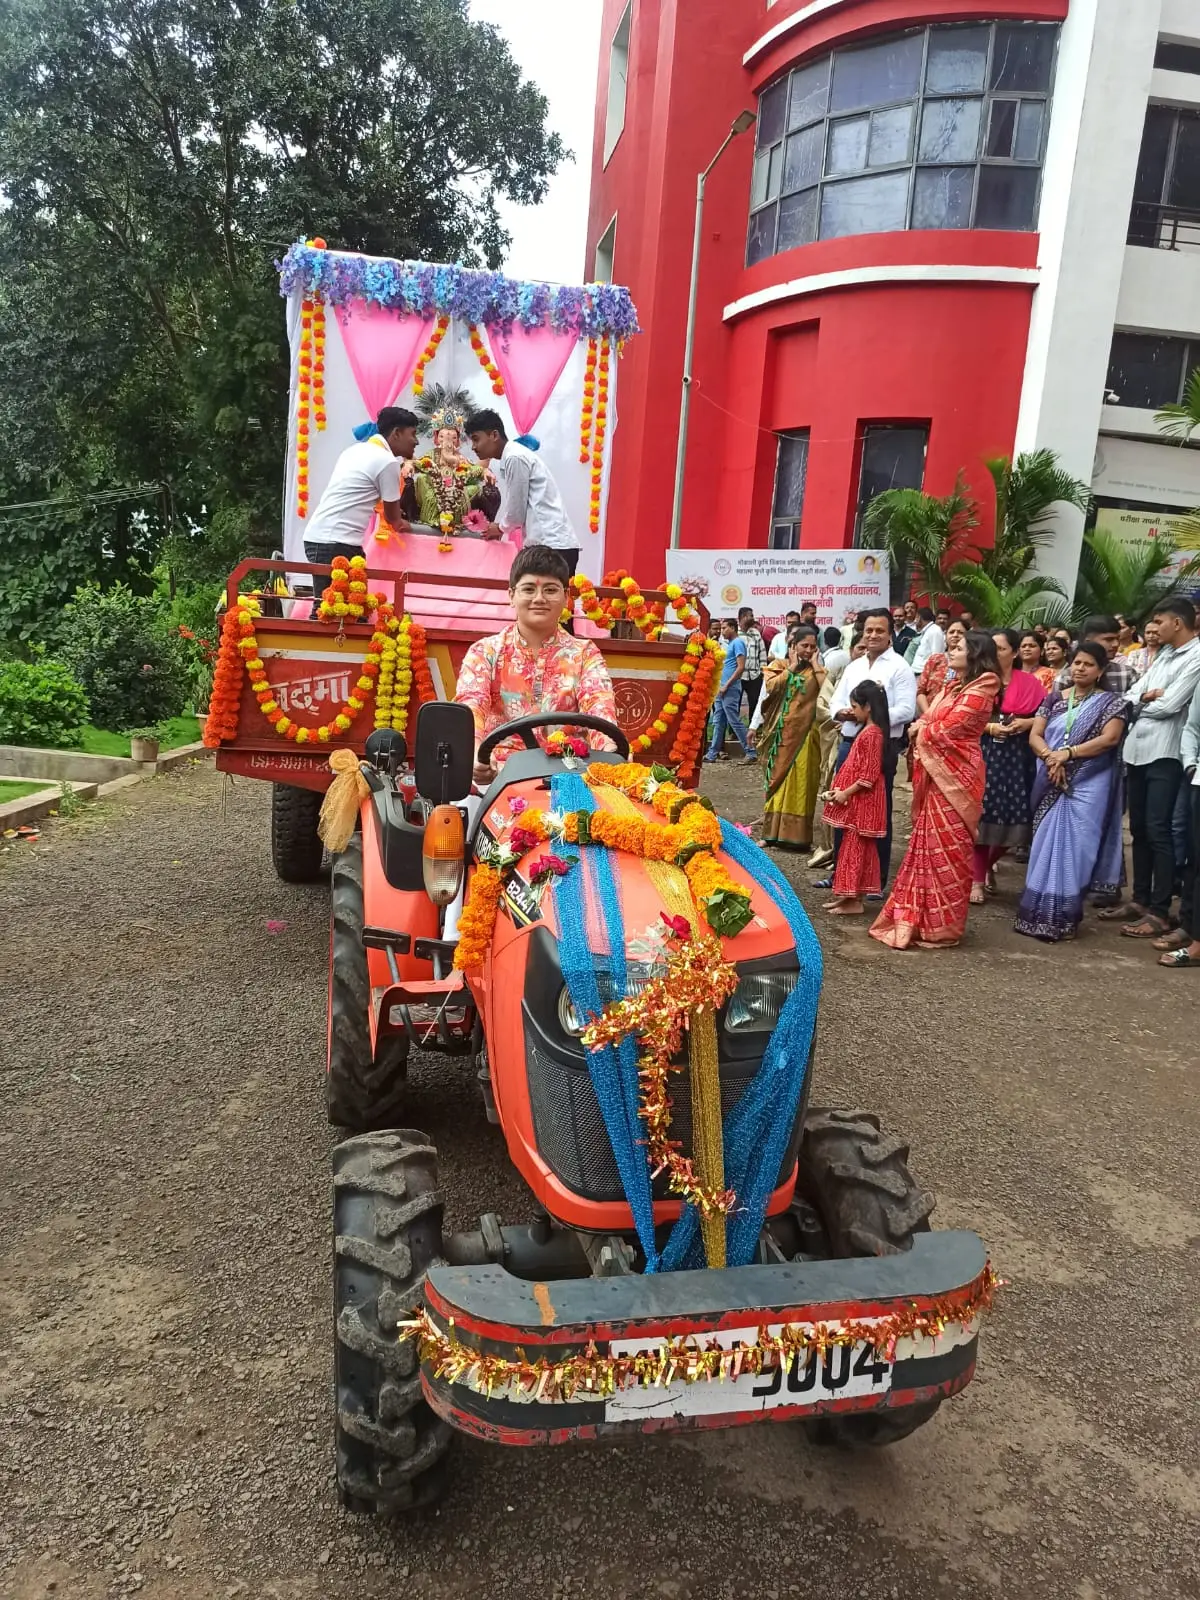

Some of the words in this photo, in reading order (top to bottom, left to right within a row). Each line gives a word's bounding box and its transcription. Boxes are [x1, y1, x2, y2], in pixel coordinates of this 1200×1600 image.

[751, 584, 786, 596] दादासाहेब
[788, 584, 818, 596] मोकाशी
[819, 584, 834, 598] कृषि
[836, 584, 881, 597] महाविद्यालय,
